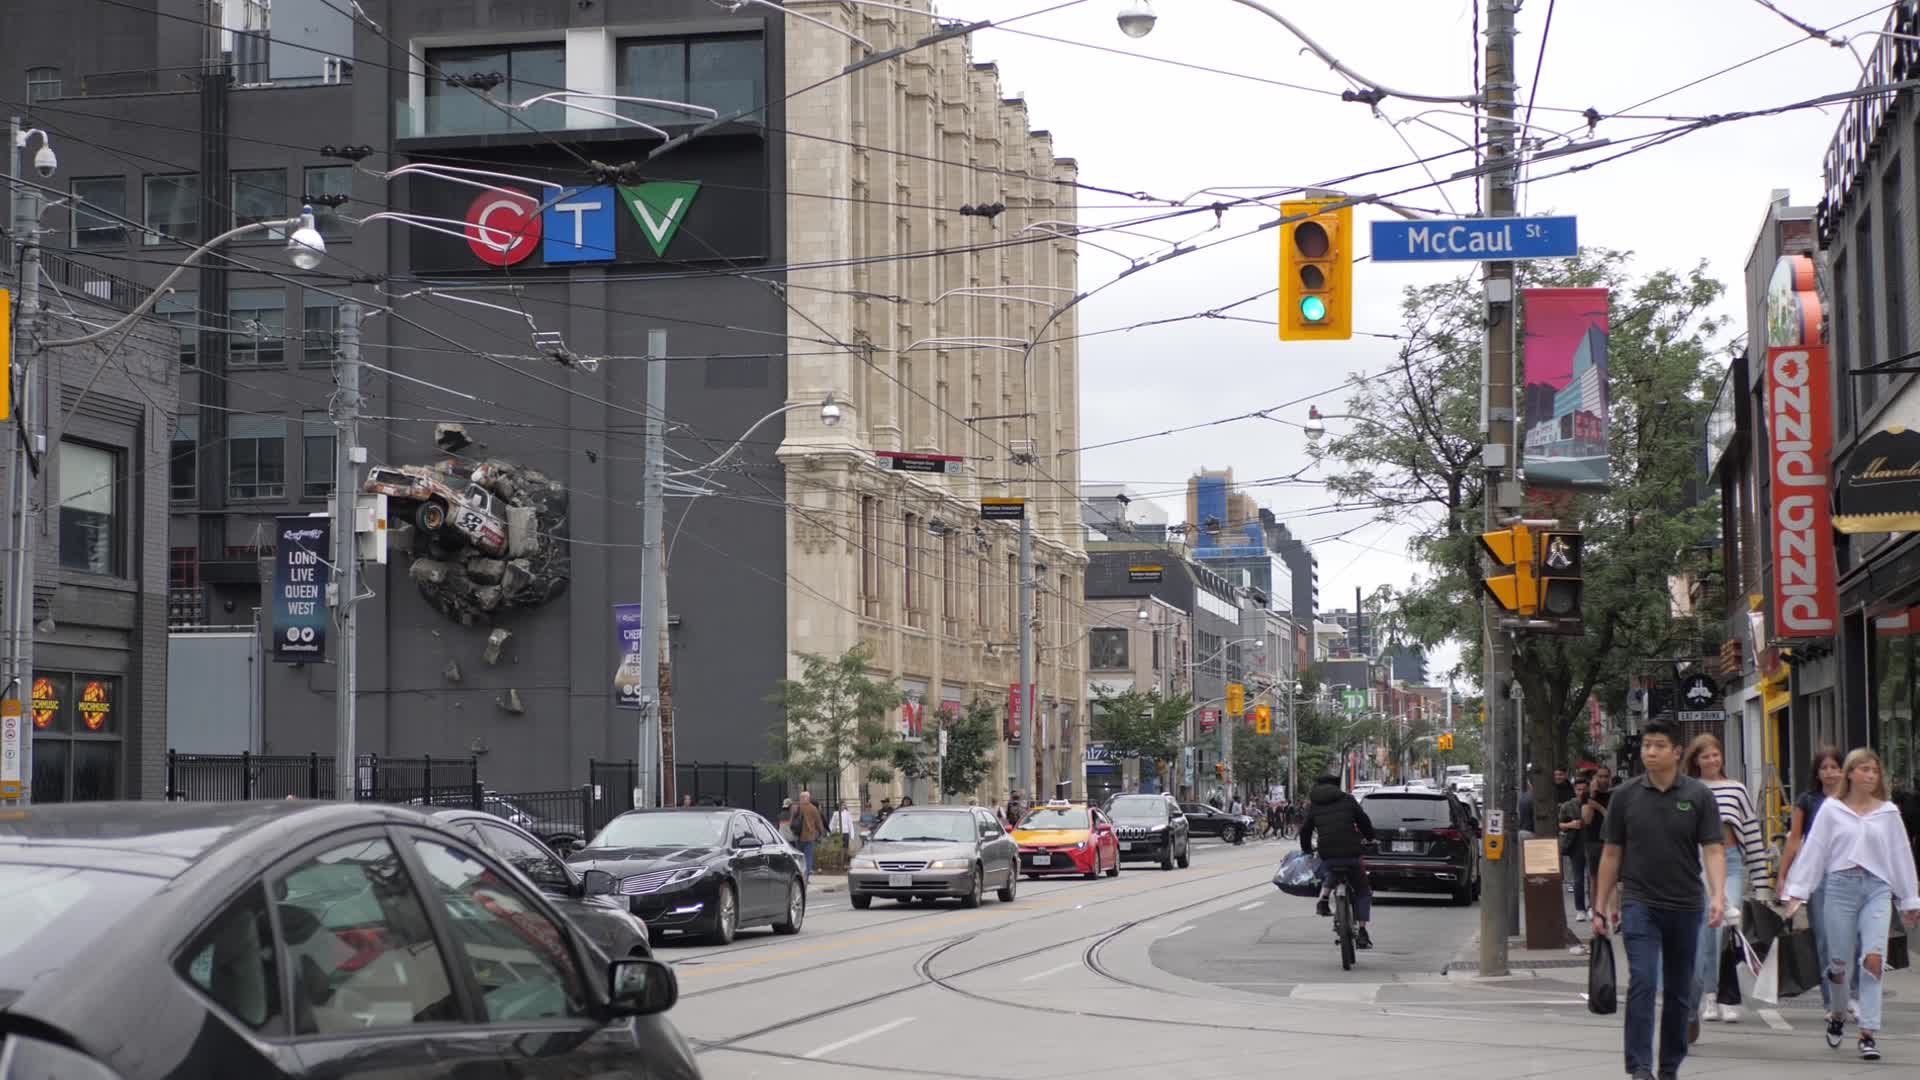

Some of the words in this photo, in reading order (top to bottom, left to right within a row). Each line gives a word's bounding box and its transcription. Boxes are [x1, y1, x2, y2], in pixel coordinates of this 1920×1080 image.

[478, 196, 684, 252] CTV
[1407, 224, 1513, 254] McCaul
[1525, 223, 1541, 239] St
[1772, 350, 1827, 487] pizza
[288, 551, 318, 566] LONG
[1778, 494, 1833, 631] pizza
[290, 567, 315, 582] LIVE
[284, 584, 319, 599] QUEEN
[287, 601, 317, 616] WEST
[1343, 694, 1364, 709] TD
